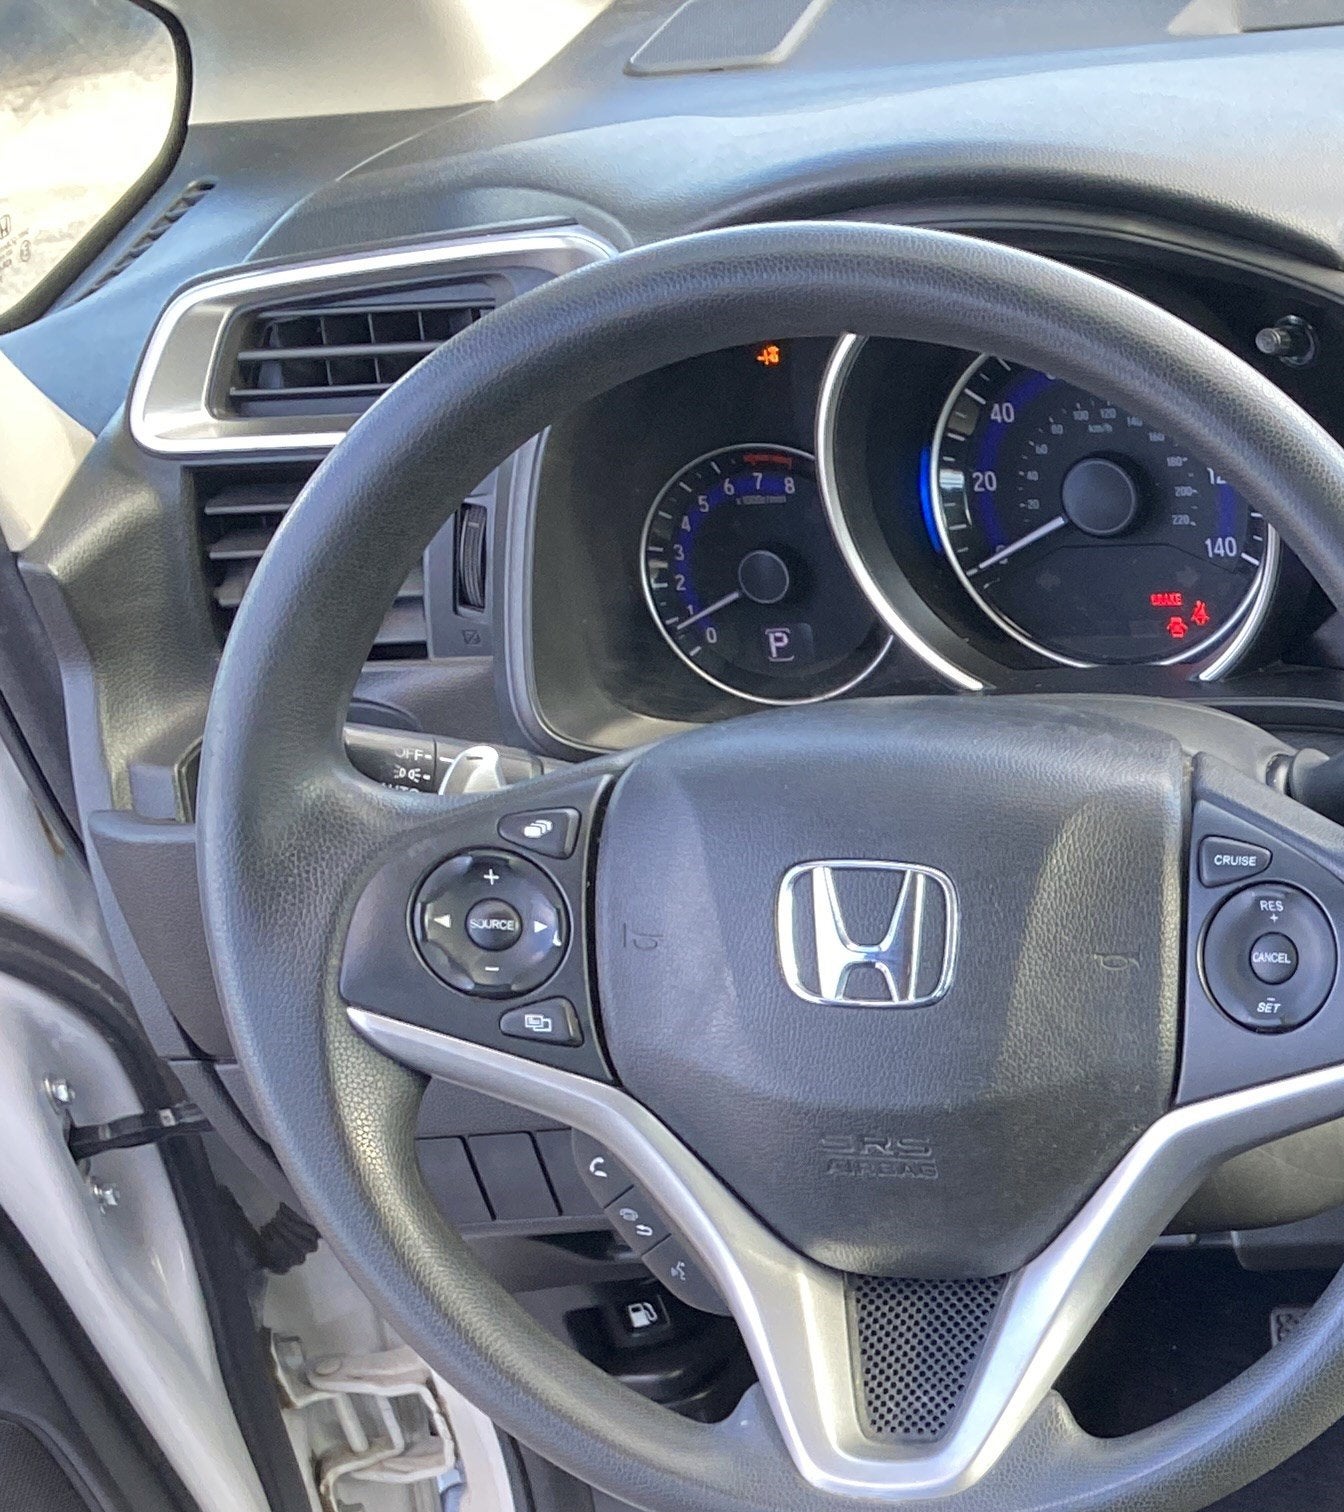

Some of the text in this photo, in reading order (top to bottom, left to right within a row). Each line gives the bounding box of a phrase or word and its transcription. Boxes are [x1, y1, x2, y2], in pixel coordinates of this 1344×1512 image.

[990, 402, 1015, 424] 40
[723, 478, 735, 496] 6
[752, 472, 763, 490] 7
[784, 476, 796, 494] 8
[973, 471, 997, 492] 20
[698, 495, 710, 513] 5
[681, 516, 692, 533] 4
[673, 544, 685, 561] 3
[1205, 537, 1237, 558] 140
[675, 574, 686, 592] 2
[706, 627, 717, 644] 0
[769, 631, 790, 658] P
[1214, 854, 1257, 867] CRUISE
[1260, 900, 1284, 912] RES
[469, 917, 515, 931] SOURCE
[1252, 953, 1291, 965] CANCEL
[1257, 1002, 1281, 1014] SET
